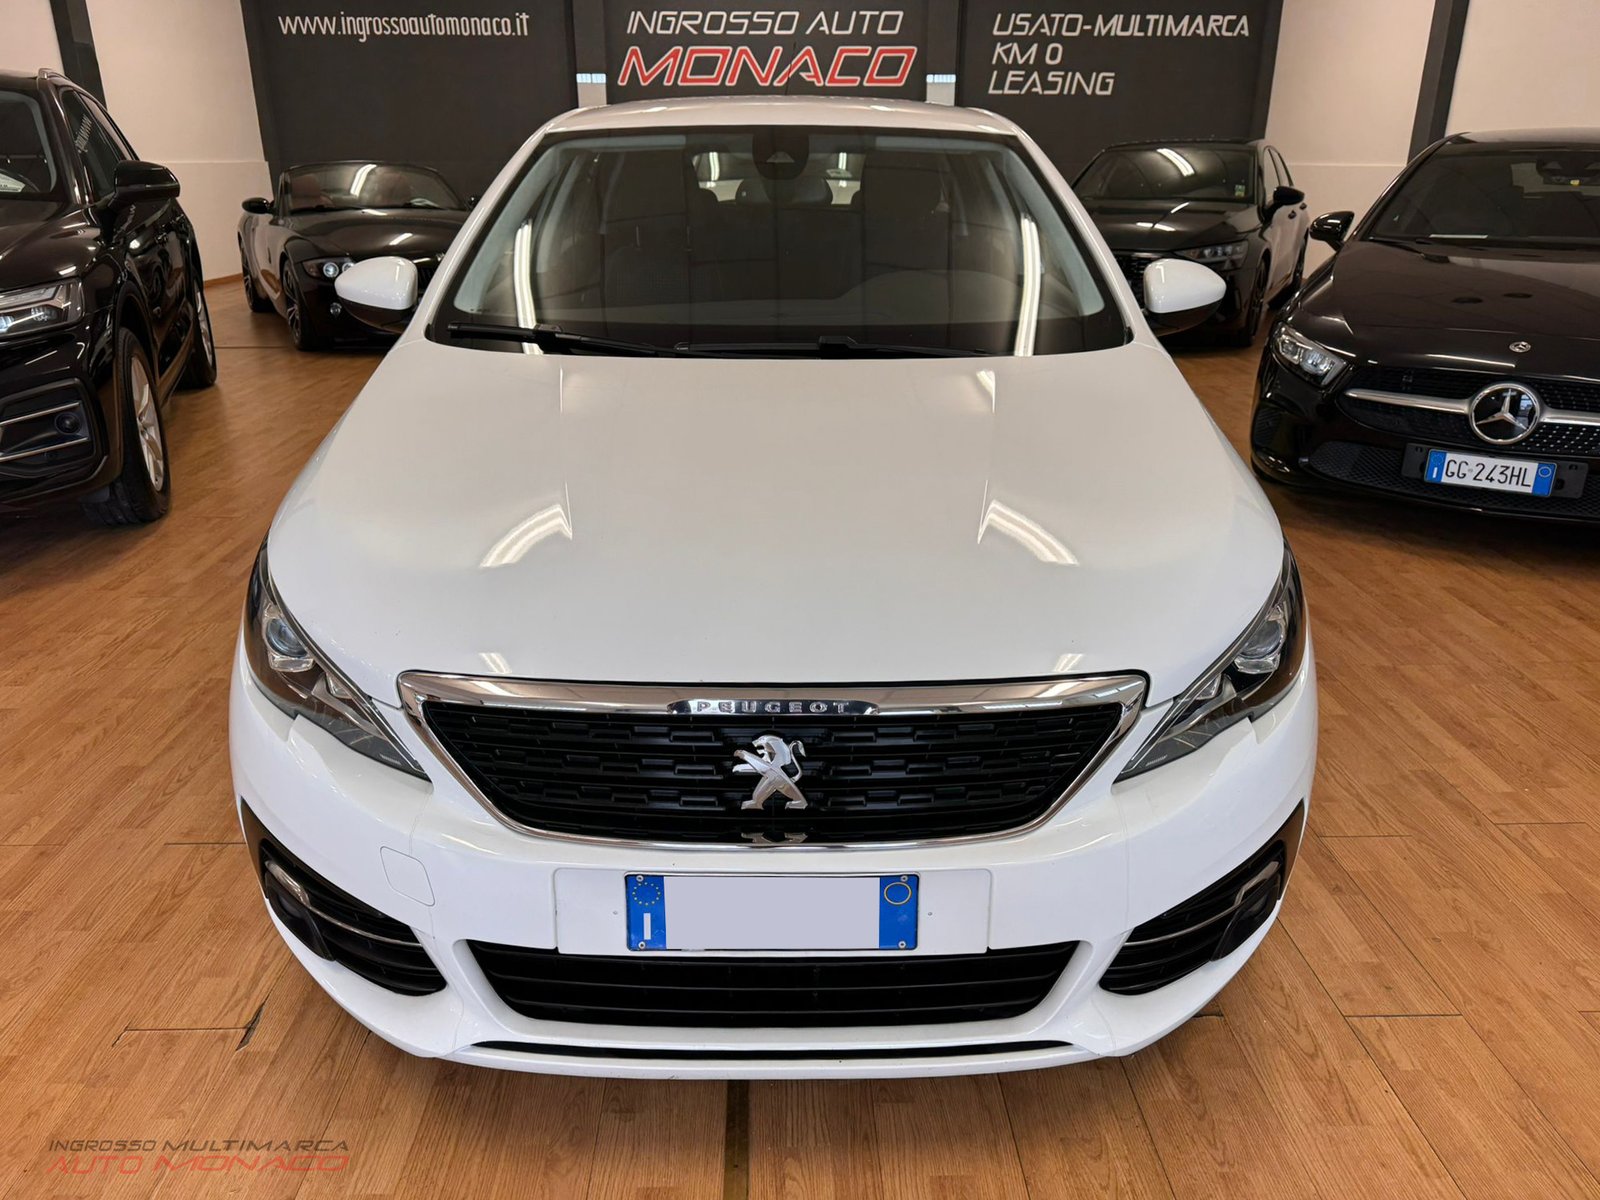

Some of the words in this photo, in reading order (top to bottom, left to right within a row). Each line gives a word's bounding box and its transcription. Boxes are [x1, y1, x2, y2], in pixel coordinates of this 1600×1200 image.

[278, 11, 529, 42] www.ingrossoautomonaco.it
[627, 11, 799, 34] INGROSSO
[806, 11, 903, 35] AUTO
[992, 13, 1249, 37] USATO-MULTIMARCA
[991, 42, 1036, 65] KM
[617, 46, 917, 86] MONACO
[987, 70, 1116, 96] LEASING
[696, 700, 850, 714] PEUGEOT
